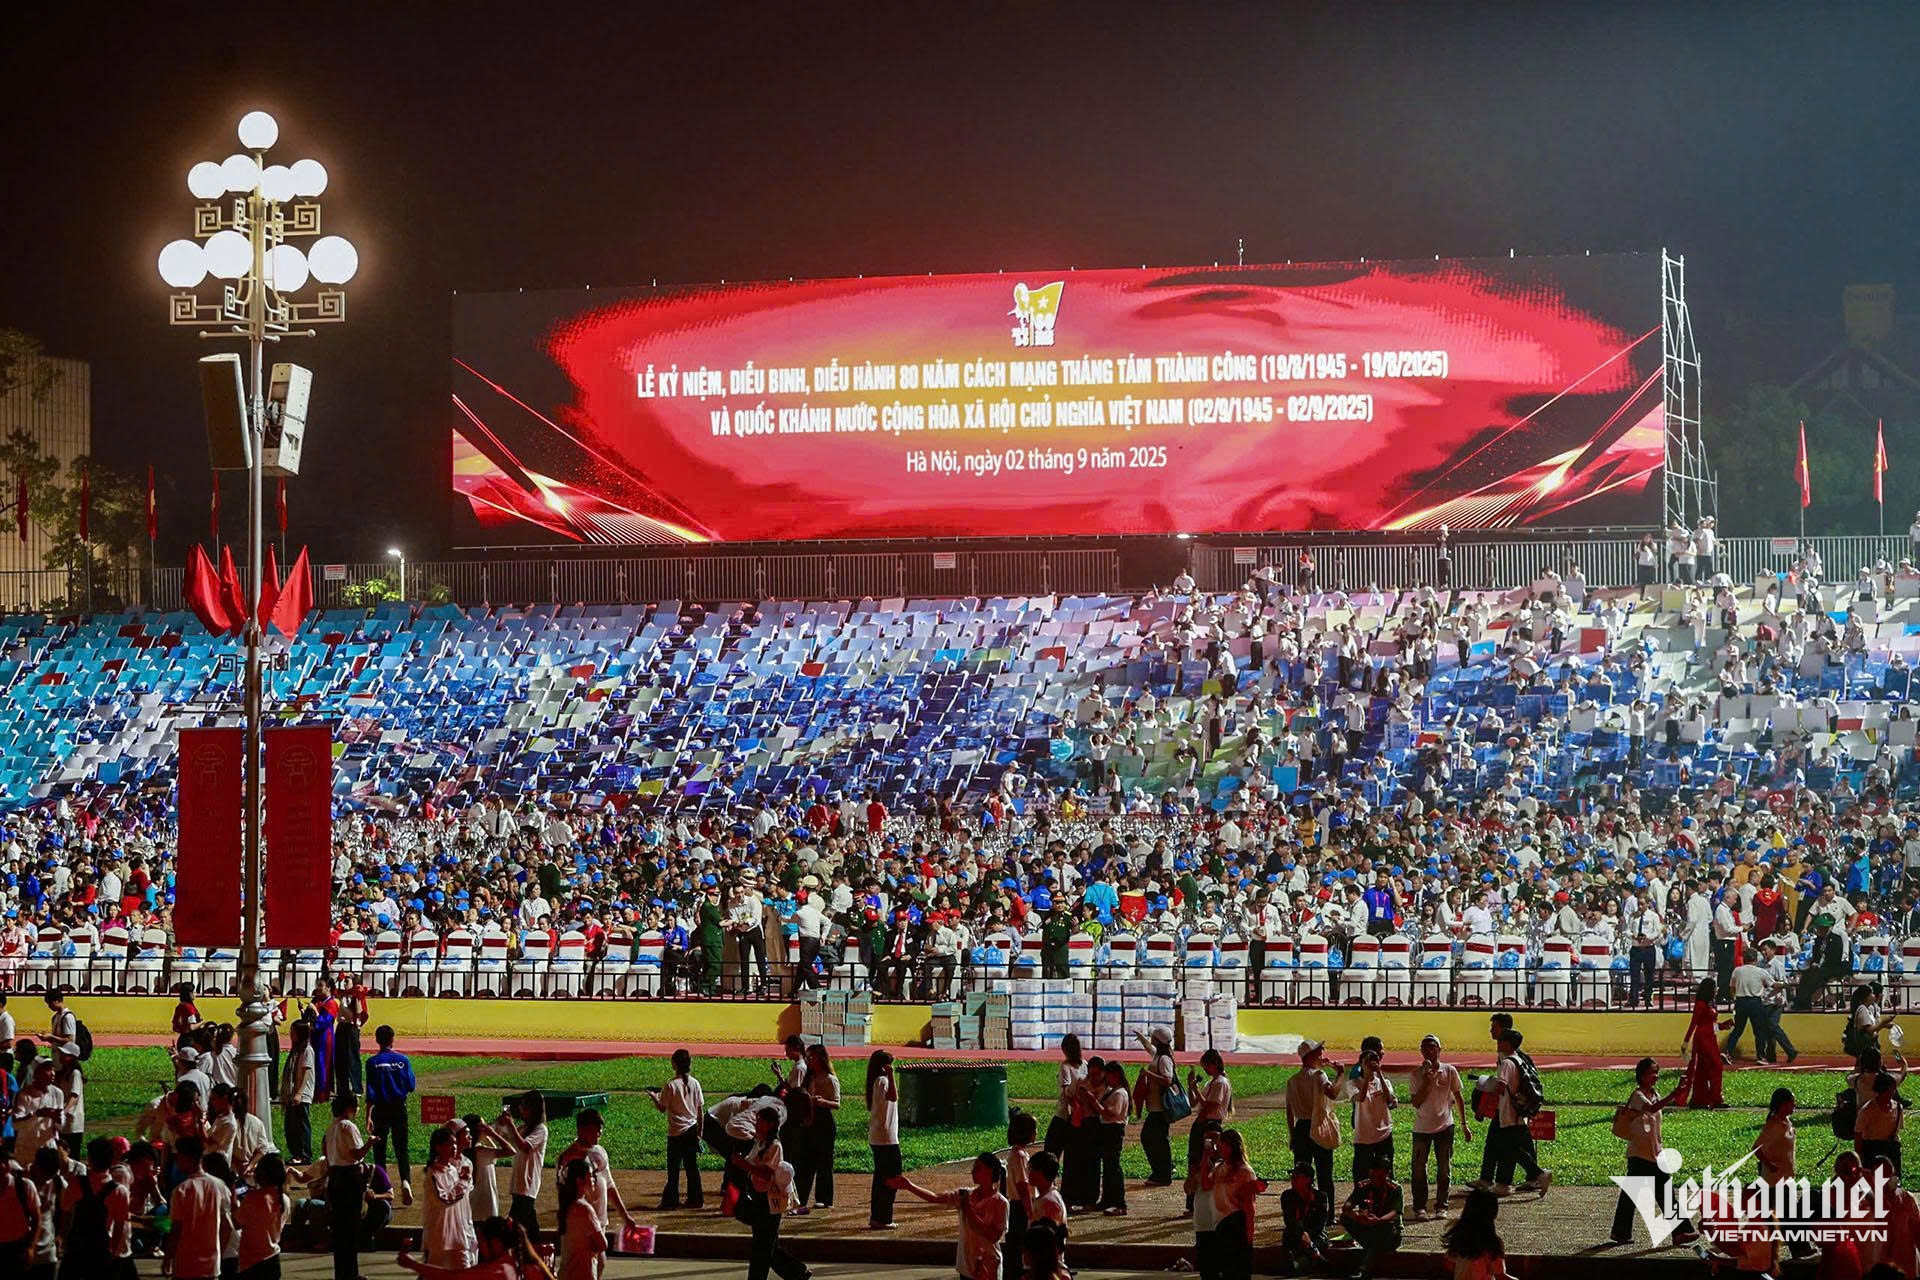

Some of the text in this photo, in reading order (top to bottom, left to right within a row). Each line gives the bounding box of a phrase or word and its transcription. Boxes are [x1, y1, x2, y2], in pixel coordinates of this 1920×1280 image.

[637, 363, 656, 398] LỄ
[658, 363, 680, 398] KỶ
[682, 365, 727, 402] NIỆM,
[729, 360, 766, 395] DIỄU
[767, 367, 811, 396] BINH,
[813, 357, 850, 393] DIỄU
[852, 360, 897, 391] HÀNH
[899, 364, 920, 390] 80
[922, 358, 961, 389] NĂM
[963, 357, 1007, 388] CÁCH
[1009, 359, 1058, 392] MẠNG
[1060, 353, 1114, 386] THÁNG
[1116, 352, 1153, 385] TÁM
[1154, 351, 1209, 384] THÀNH
[1211, 350, 1258, 383] CÔNG
[1260, 352, 1347, 384] (19/8/1945
[1361, 349, 1450, 379] 19/8/2025)
[710, 405, 732, 436] VÀ
[733, 400, 776, 438] QUỐC
[778, 402, 832, 434] KHÁNH
[834, 401, 879, 433] NƯỚC
[881, 400, 925, 437] CỘNG
[927, 398, 961, 430] HÒA
[963, 399, 986, 429] XÃ
[988, 397, 1017, 434] HỘI
[1019, 393, 1053, 428] CHỦ
[1055, 395, 1106, 427] NGHĨA
[1107, 394, 1143, 431] VIỆT
[1145, 397, 1185, 425] NAM
[1187, 396, 1274, 427] (02/9/1945
[1286, 393, 1374, 423] 02/9/2025)
[906, 445, 1168, 477] Hà Nội, ngày 02 tháng 9 năm 2025
